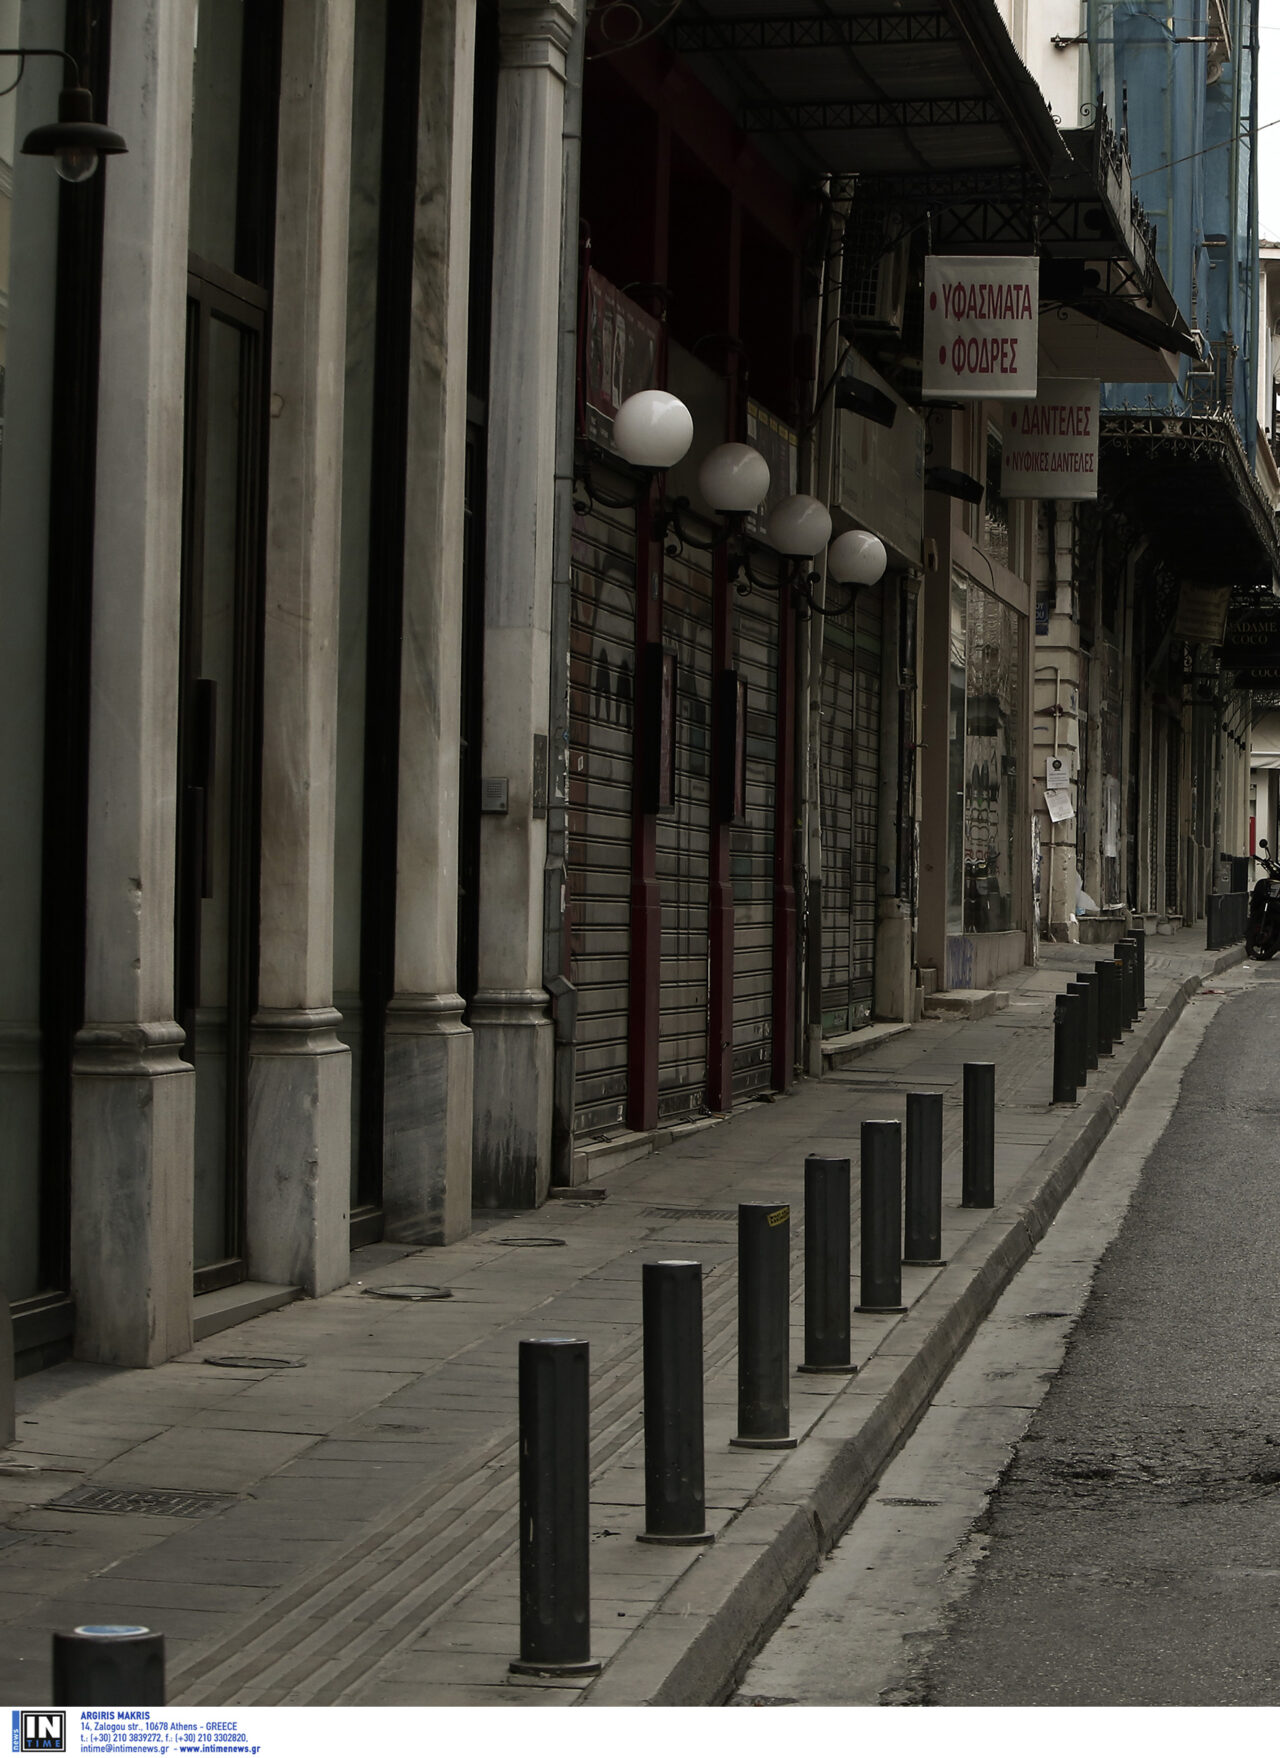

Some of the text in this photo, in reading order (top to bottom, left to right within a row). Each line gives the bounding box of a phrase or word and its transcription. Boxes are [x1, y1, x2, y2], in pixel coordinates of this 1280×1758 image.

[941, 281, 1033, 322] ΥΦΑΣΜΑΤΑ
[951, 335, 1018, 376] ΦΟΔΡΕΣ
[1020, 404, 1091, 437] ΔΑΝΤΕΛΕΣ
[1012, 451, 1094, 473] ΝΥΦΙΚΕΣ ΔΑΝΤΕΛΕΣ
[1227, 621, 1278, 633] MADAME
[1231, 634, 1269, 645] COCO
